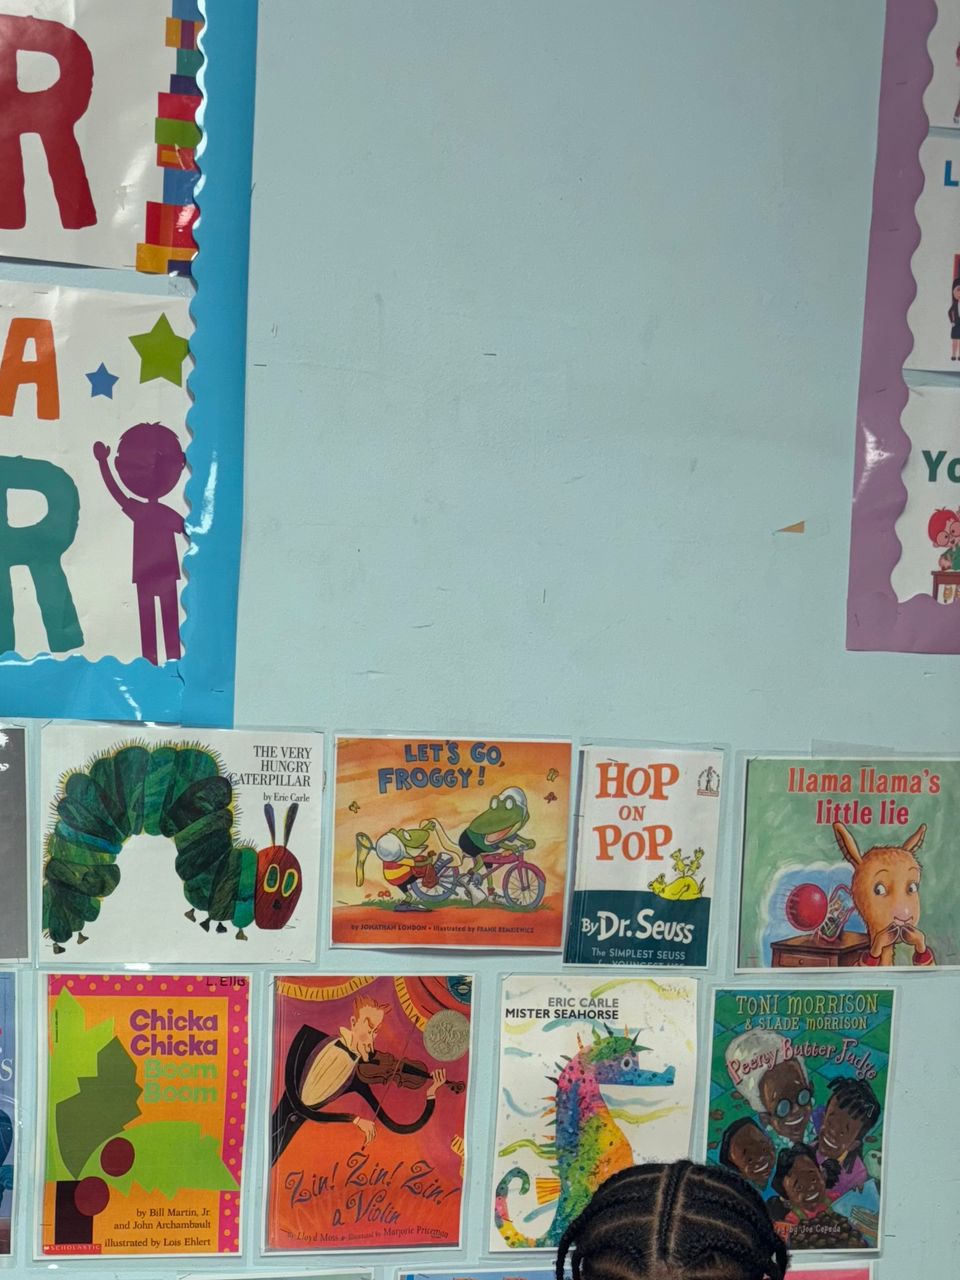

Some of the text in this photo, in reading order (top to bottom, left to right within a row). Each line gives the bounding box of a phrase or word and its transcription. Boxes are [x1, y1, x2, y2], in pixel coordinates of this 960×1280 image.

[253, 745, 312, 760] THE VERY
[404, 740, 505, 768] LET'S GO,
[260, 759, 312, 773] HUNGRY
[229, 772, 311, 787] CATERPILLAR
[595, 762, 680, 800] HOP
[788, 767, 940, 794] llama llama's
[263, 792, 310, 803] by Eric Carle
[618, 805, 646, 821] ON
[816, 799, 909, 825] little lie
[592, 824, 673, 861] POP
[581, 908, 694, 944] By Dr. Seuss
[592, 947, 686, 960] The SIMPLEST SEUSS
[547, 997, 619, 1008] ERIC CARLE
[736, 993, 878, 1016] TONI MORRISON
[130, 1008, 218, 1032] Chicka
[505, 1008, 619, 1020] MISTER SEAHORSE
[744, 1016, 867, 1030] & SLADE MORRISON
[130, 1033, 218, 1057] Chicka
[143, 1058, 218, 1080] Boom
[781, 1037, 837, 1060] Butter
[835, 1038, 877, 1080] Fudge
[143, 1082, 218, 1104] Boom
[285, 1151, 460, 1209] Zin! Zin! Zin!
[136, 1208, 146, 1219] by
[149, 1208, 165, 1217] Bill
[167, 1207, 198, 1217] Martin,
[332, 1188, 402, 1226] a Violin
[114, 1219, 211, 1230] and John Archambault
